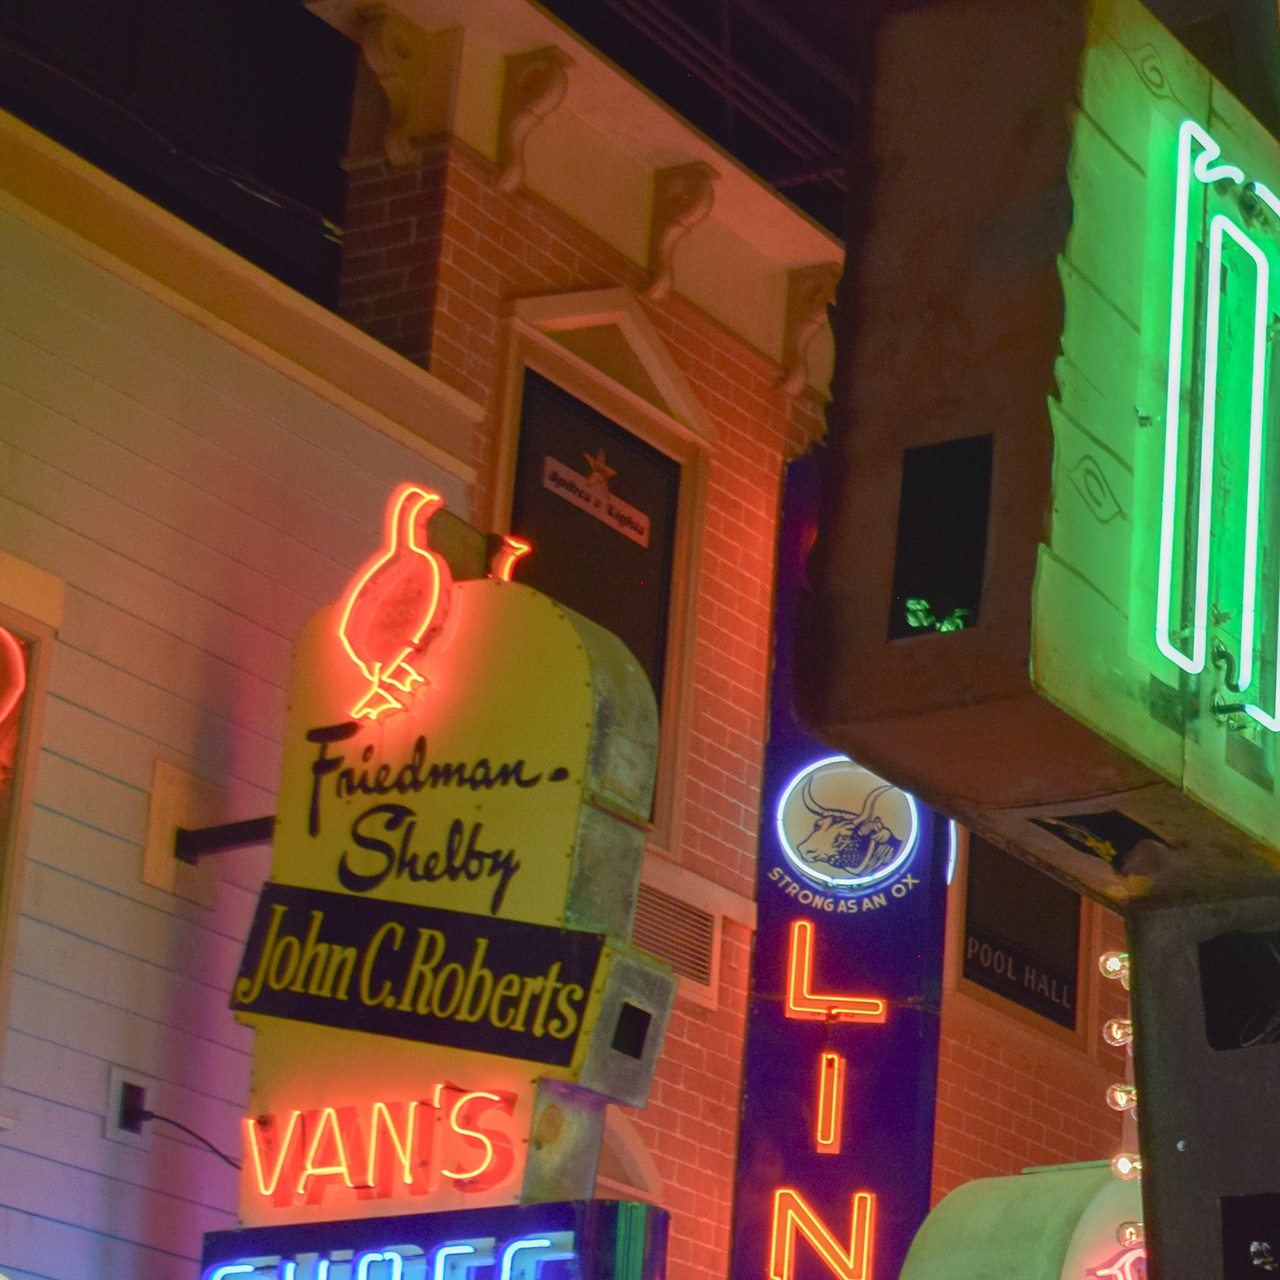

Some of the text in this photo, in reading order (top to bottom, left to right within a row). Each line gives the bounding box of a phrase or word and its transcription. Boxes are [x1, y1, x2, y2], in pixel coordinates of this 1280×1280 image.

[338, 804, 522, 915] Shelby
[767, 866, 920, 914] STRONG AS AN OX
[236, 903, 374, 1007] John
[398, 925, 584, 1040] Roberts
[967, 936, 1071, 1009] POOL HALL
[244, 1084, 518, 1206] VAN'S
